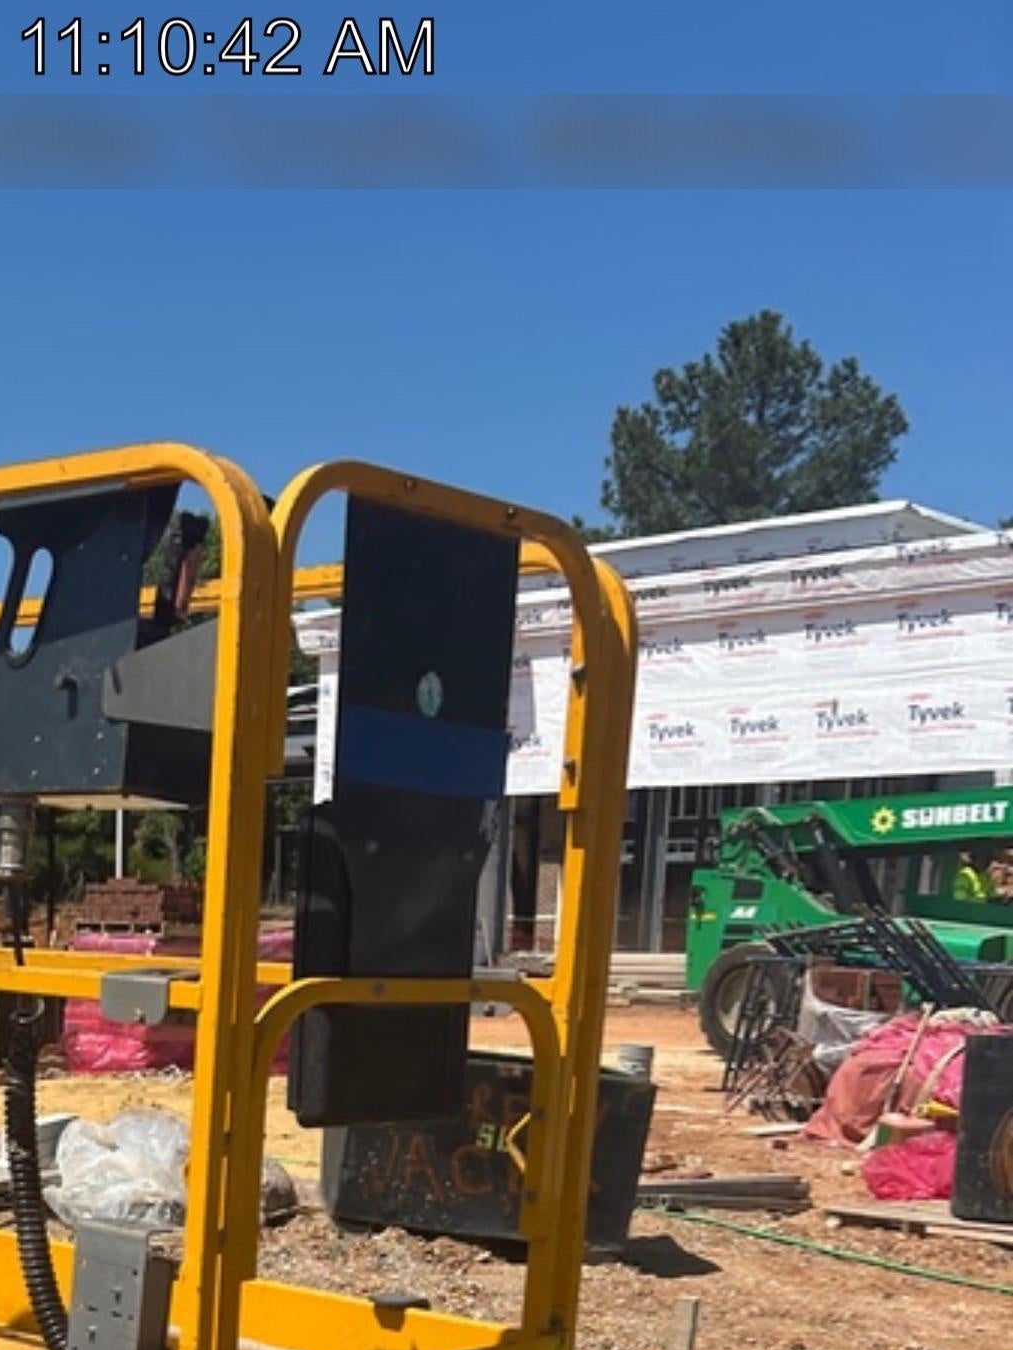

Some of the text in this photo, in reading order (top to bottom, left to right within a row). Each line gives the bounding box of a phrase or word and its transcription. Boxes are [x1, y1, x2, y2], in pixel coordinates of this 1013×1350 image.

[804, 619, 857, 643] Tyvek
[895, 608, 952, 634] Tyvek
[718, 629, 767, 653] Tyvek
[731, 715, 780, 736] Tyvek
[815, 707, 869, 732] Tyvek
[908, 701, 965, 726] Tyvek
[649, 722, 696, 742] Tyvek
[901, 801, 1009, 829] SUNBELT
